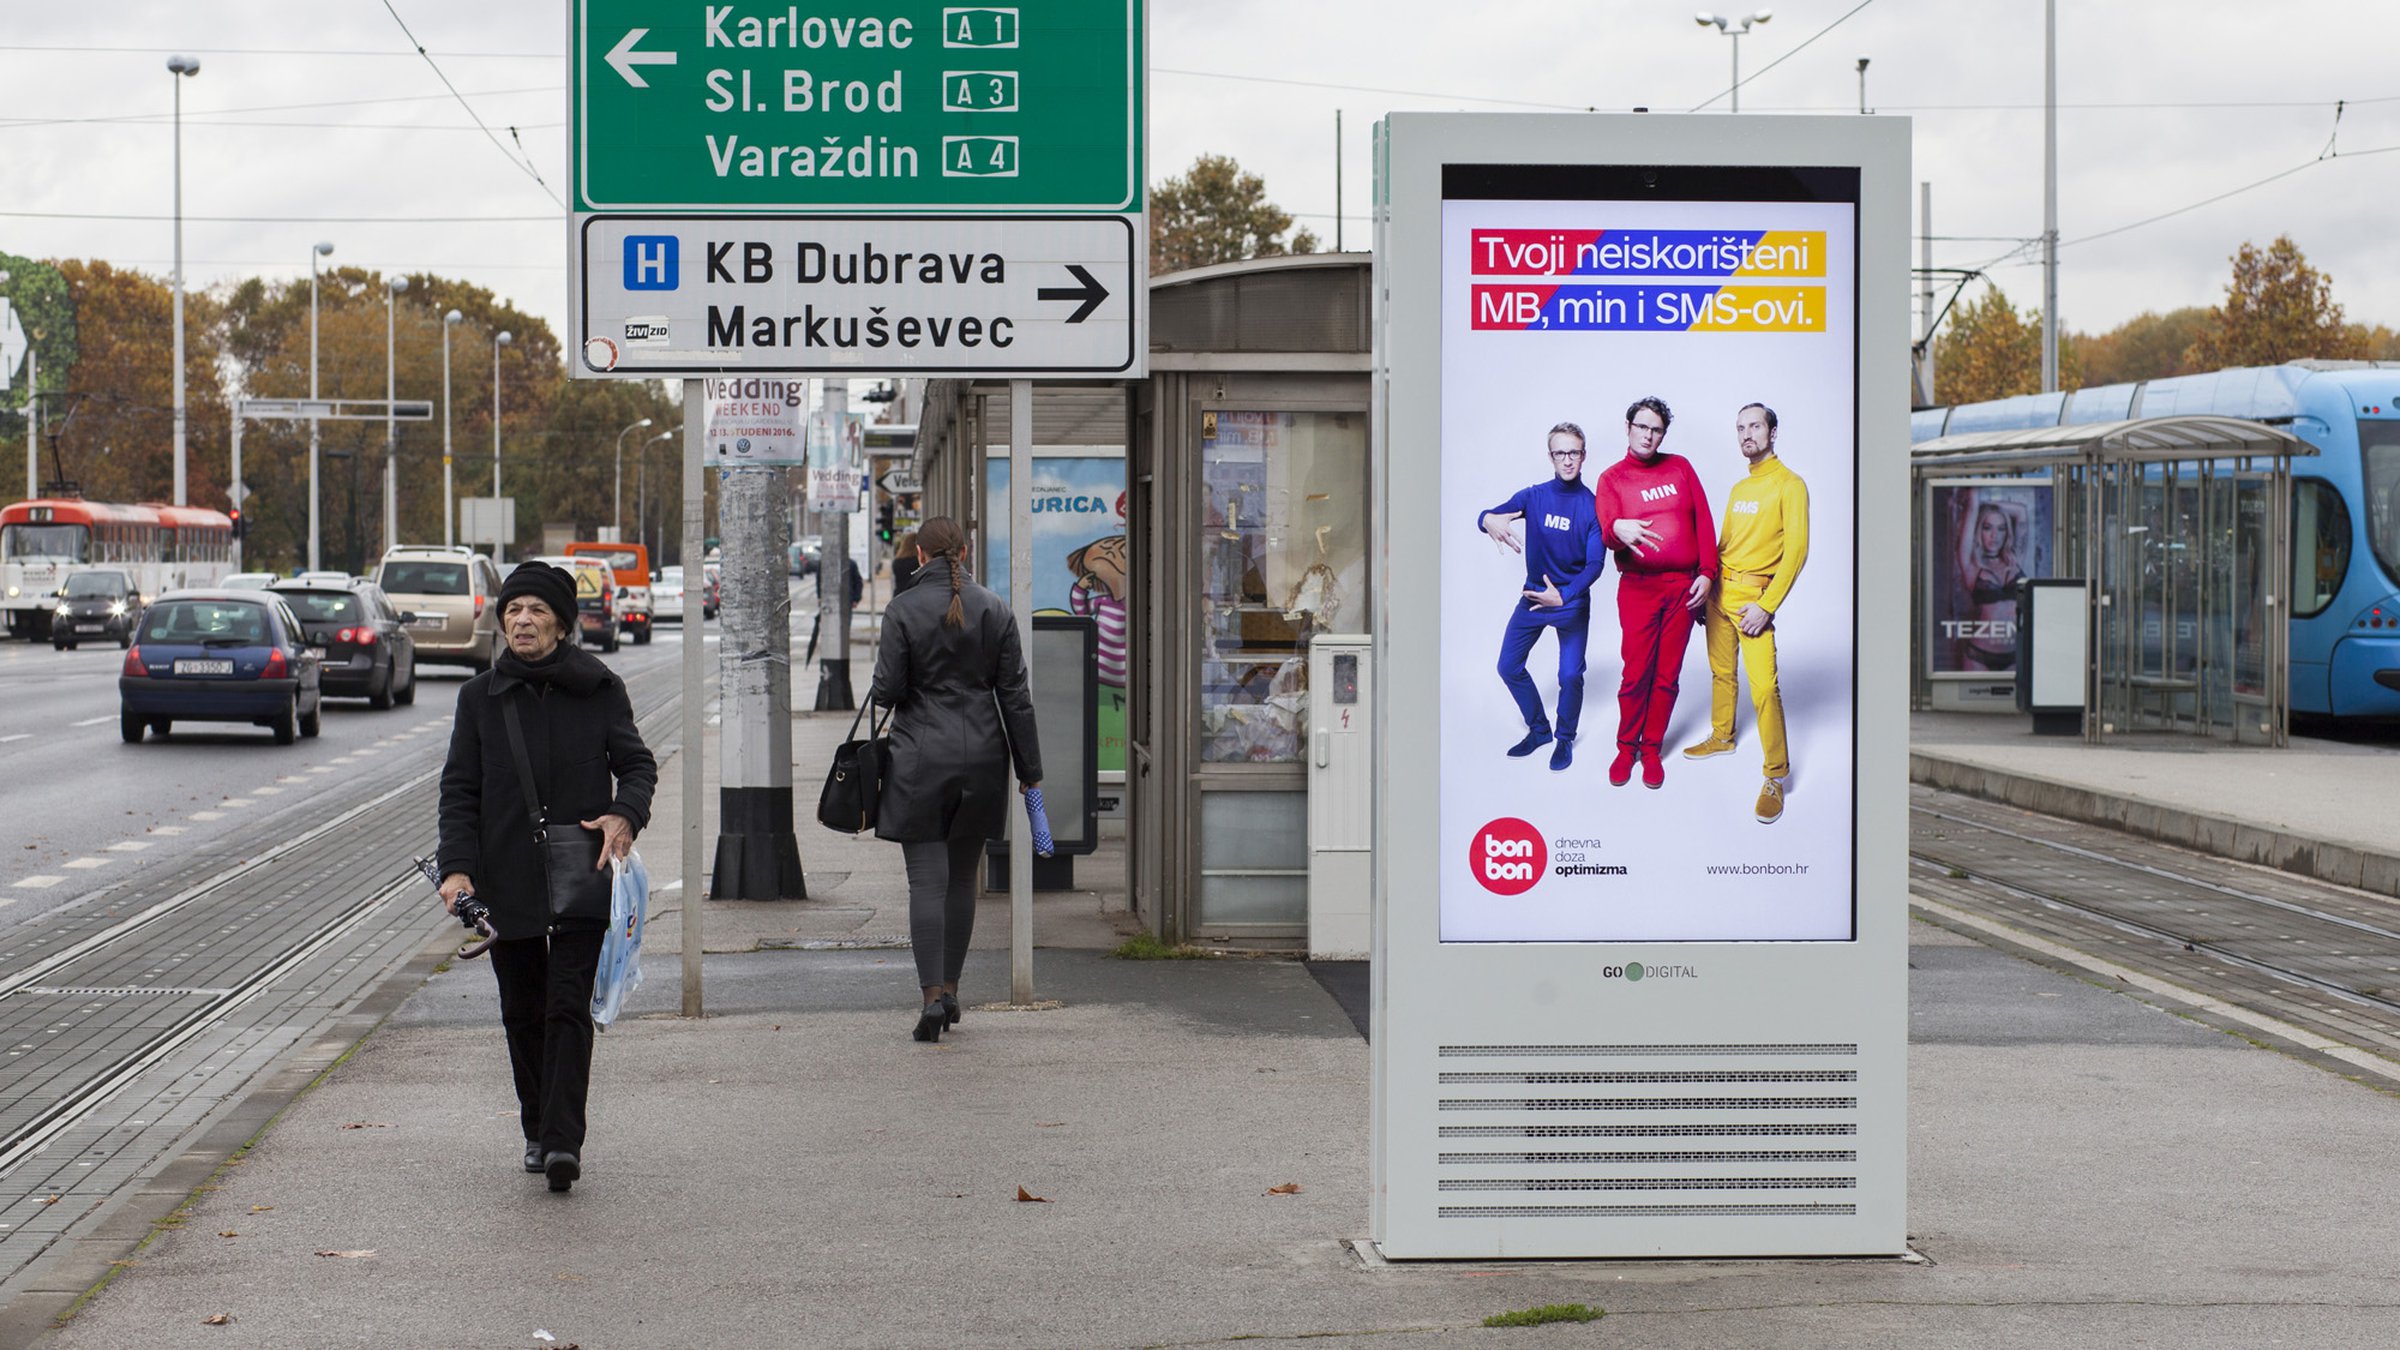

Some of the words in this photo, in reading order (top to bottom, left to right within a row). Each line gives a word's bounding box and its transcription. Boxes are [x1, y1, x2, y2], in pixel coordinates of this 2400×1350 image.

[705, 6, 913, 48] Karlovac
[705, 69, 767, 112] Sl.
[784, 70, 902, 112] Brod
[705, 135, 918, 178] Varaždin
[637, 243, 665, 283] H
[706, 241, 774, 284] KB
[797, 242, 1005, 285] Dubrava
[1479, 236, 1565, 275] Tvoji
[1577, 237, 1808, 271] neiskorišteni
[1480, 291, 1549, 329] MB,
[1559, 290, 1626, 324] min
[1638, 290, 1645, 324] i
[1656, 291, 1813, 325] SMS-ovi.
[650, 327, 667, 336] ZID
[707, 305, 1014, 348] Markuševec
[705, 379, 803, 407] Wedding
[1641, 483, 1678, 503] MIN
[1032, 496, 1108, 514] URICA
[1732, 500, 1760, 515] SMS
[1544, 513, 1571, 532] MB
[1940, 621, 2016, 639] TEZEN
[1485, 834, 1533, 857] bon
[1554, 837, 1602, 849] dnevna
[1554, 850, 1586, 863] doza
[1485, 858, 1533, 881] bon
[1555, 863, 1628, 878] optimizma
[1706, 862, 1809, 875] www.bonbon.hr
[1602, 966, 1623, 978] GO
[1645, 966, 1698, 978] DIGITAL
